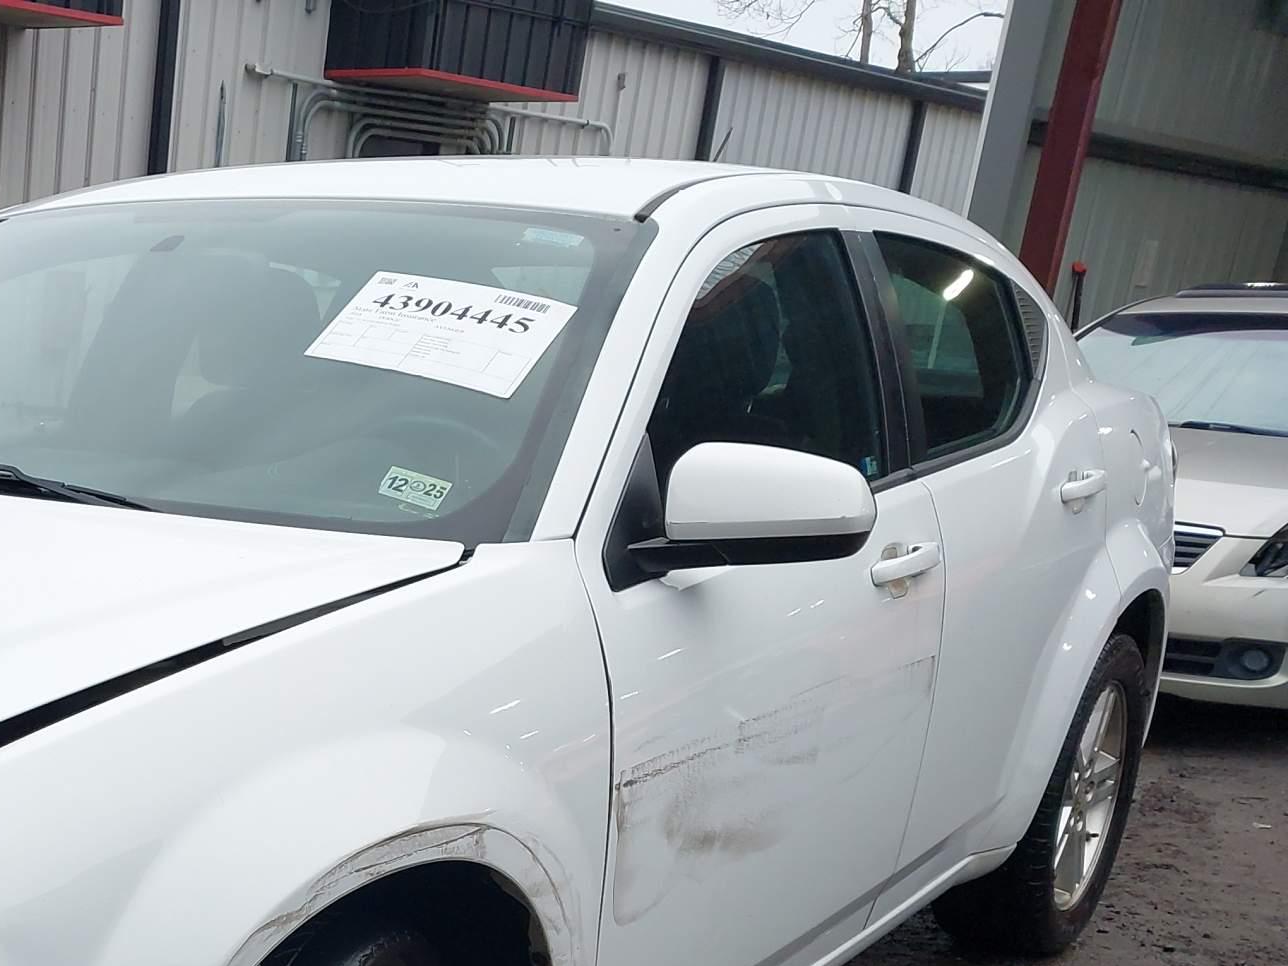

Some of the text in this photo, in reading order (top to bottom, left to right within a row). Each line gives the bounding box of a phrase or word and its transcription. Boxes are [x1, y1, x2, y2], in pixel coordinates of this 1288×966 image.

[372, 293, 536, 333] 43904445
[388, 475, 448, 499] 12 25
